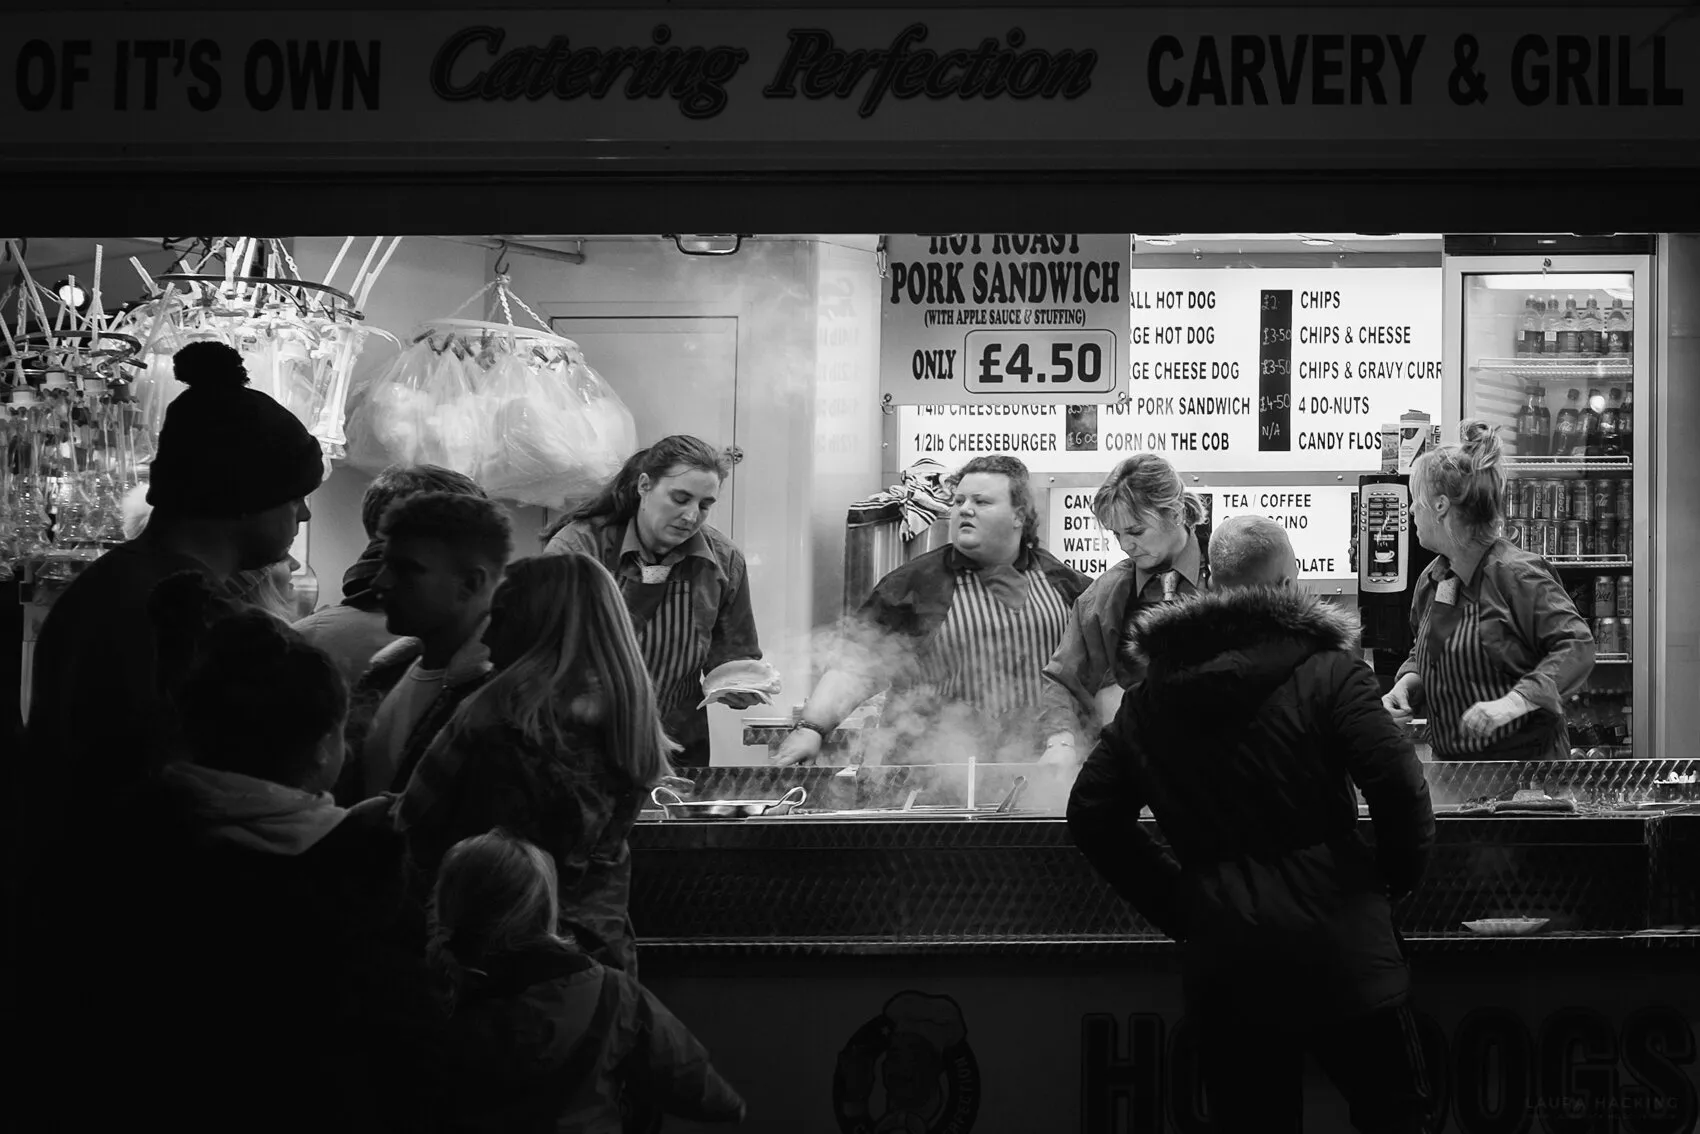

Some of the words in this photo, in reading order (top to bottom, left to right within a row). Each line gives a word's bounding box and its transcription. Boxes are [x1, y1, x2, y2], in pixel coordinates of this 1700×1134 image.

[15, 38, 91, 111] OF
[113, 38, 221, 111] IT'S
[244, 38, 382, 111] OWN
[430, 25, 749, 120] Catering
[762, 22, 1099, 118] Perfection
[1147, 34, 1425, 107] CARVERY
[1448, 32, 1489, 106] &
[1511, 33, 1683, 106] GRILL
[890, 261, 965, 304] PORK
[973, 261, 1120, 304] SANDWICH
[1156, 291, 1184, 309] HOT
[1188, 291, 1216, 309] DOG
[1301, 291, 1341, 309] CHIPS
[924, 309, 954, 327] (WITH
[956, 309, 986, 325] APPLE
[989, 309, 1021, 325] SAUCE
[1034, 309, 1086, 327] STUFFING)
[1155, 327, 1182, 344] HOT
[1187, 327, 1215, 344] DOG
[1300, 326, 1340, 344] CHIPS
[1345, 326, 1353, 344] &
[1359, 326, 1411, 344] CHESSE
[912, 349, 956, 380] ONLY
[979, 343, 1101, 383] £4.50
[1155, 362, 1206, 380] CHEESE
[1212, 362, 1239, 380] DOG
[1299, 361, 1339, 379] CHIPS
[1344, 361, 1353, 379] &
[1137, 397, 1174, 415] PORK
[1179, 397, 1250, 415] SANDWICH
[1298, 396, 1306, 414] 4
[1311, 396, 1369, 414] DO-NUTS
[914, 433, 944, 451] 1/2lb
[949, 433, 1056, 451] CHEESEBURGER
[1105, 433, 1142, 451] CORN
[1147, 433, 1166, 451] ON
[1171, 433, 1197, 450] THE
[1202, 433, 1229, 450] COB
[1298, 432, 1344, 449] CANDY
[1223, 494, 1248, 507] TEA
[1260, 494, 1312, 507] COFFEE
